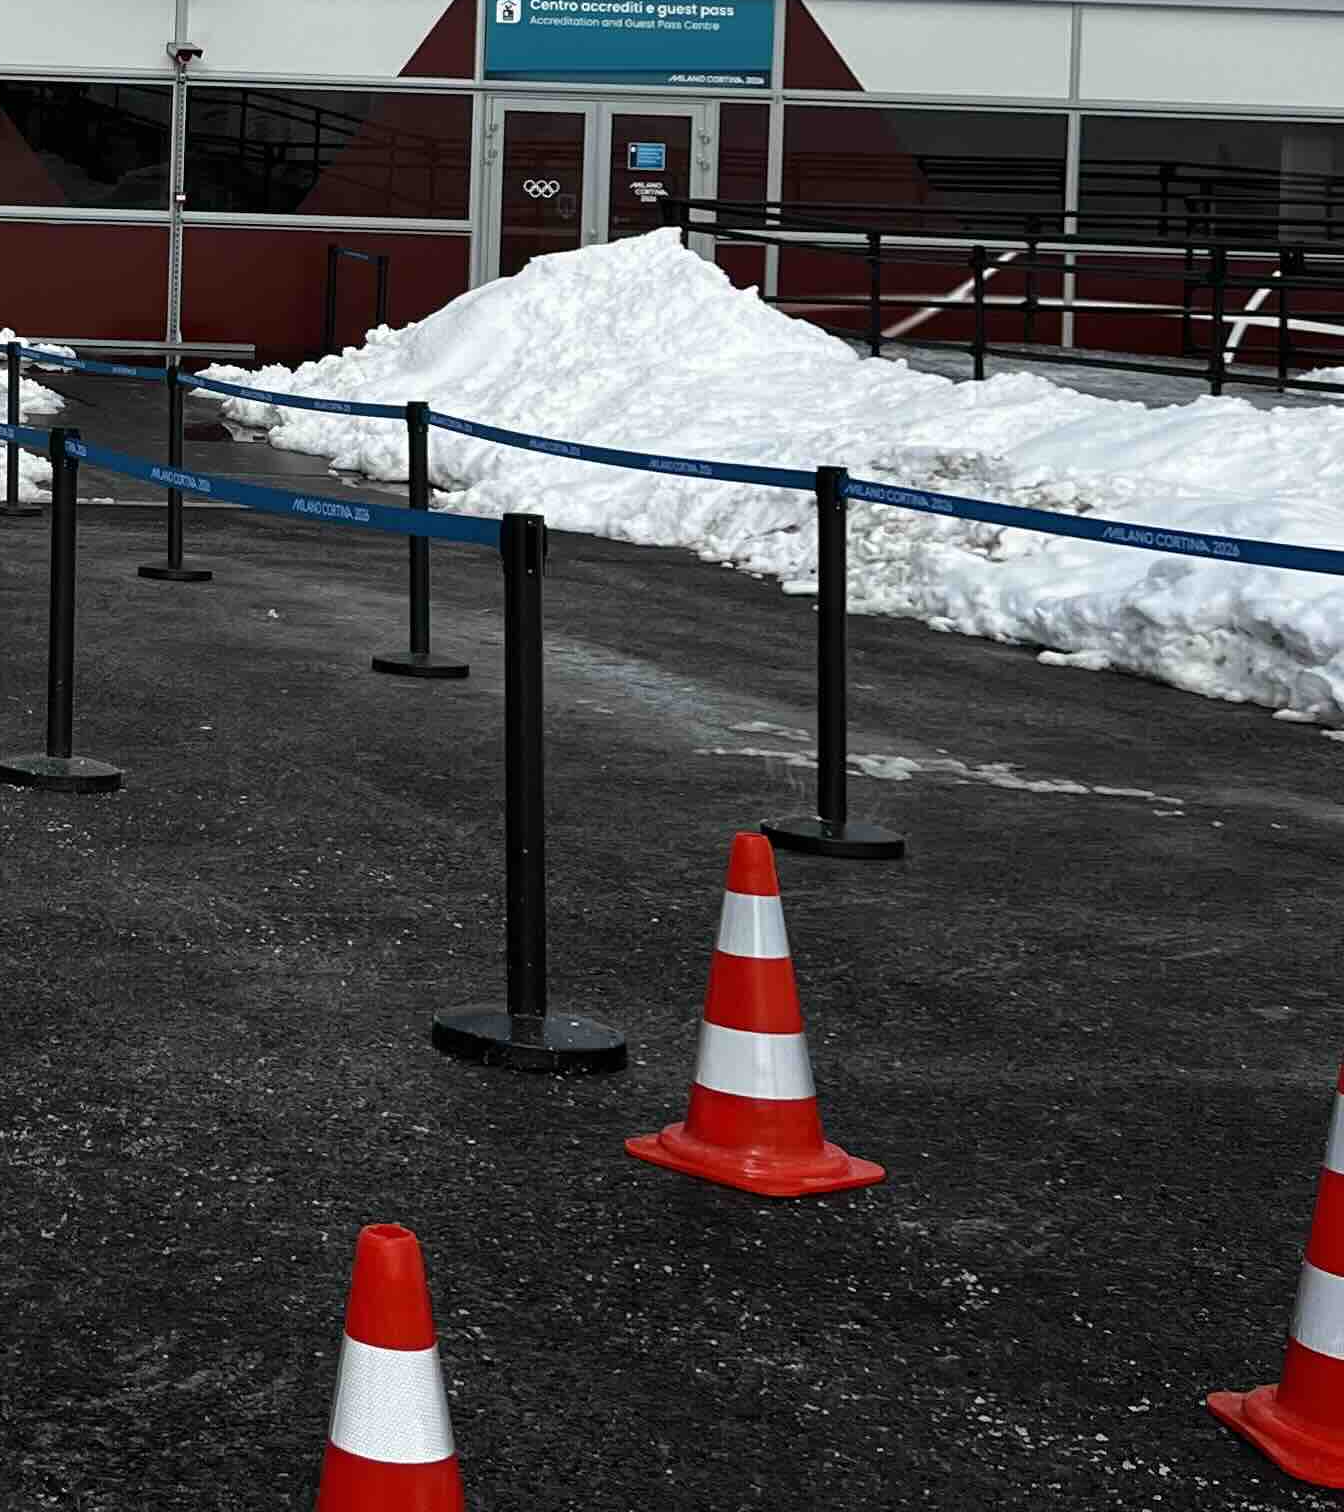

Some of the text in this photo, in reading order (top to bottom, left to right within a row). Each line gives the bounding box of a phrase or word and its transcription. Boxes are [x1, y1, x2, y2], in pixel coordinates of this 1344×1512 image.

[581, 0, 643, 13] accrediti
[645, 3, 655, 13] e
[657, 3, 698, 18] guest
[700, 6, 734, 19] pass
[529, 15, 720, 31] Accreditation and Guest Pass Centre
[1103, 526, 1153, 545] MILANO
[1155, 533, 1210, 553] CORTINA
